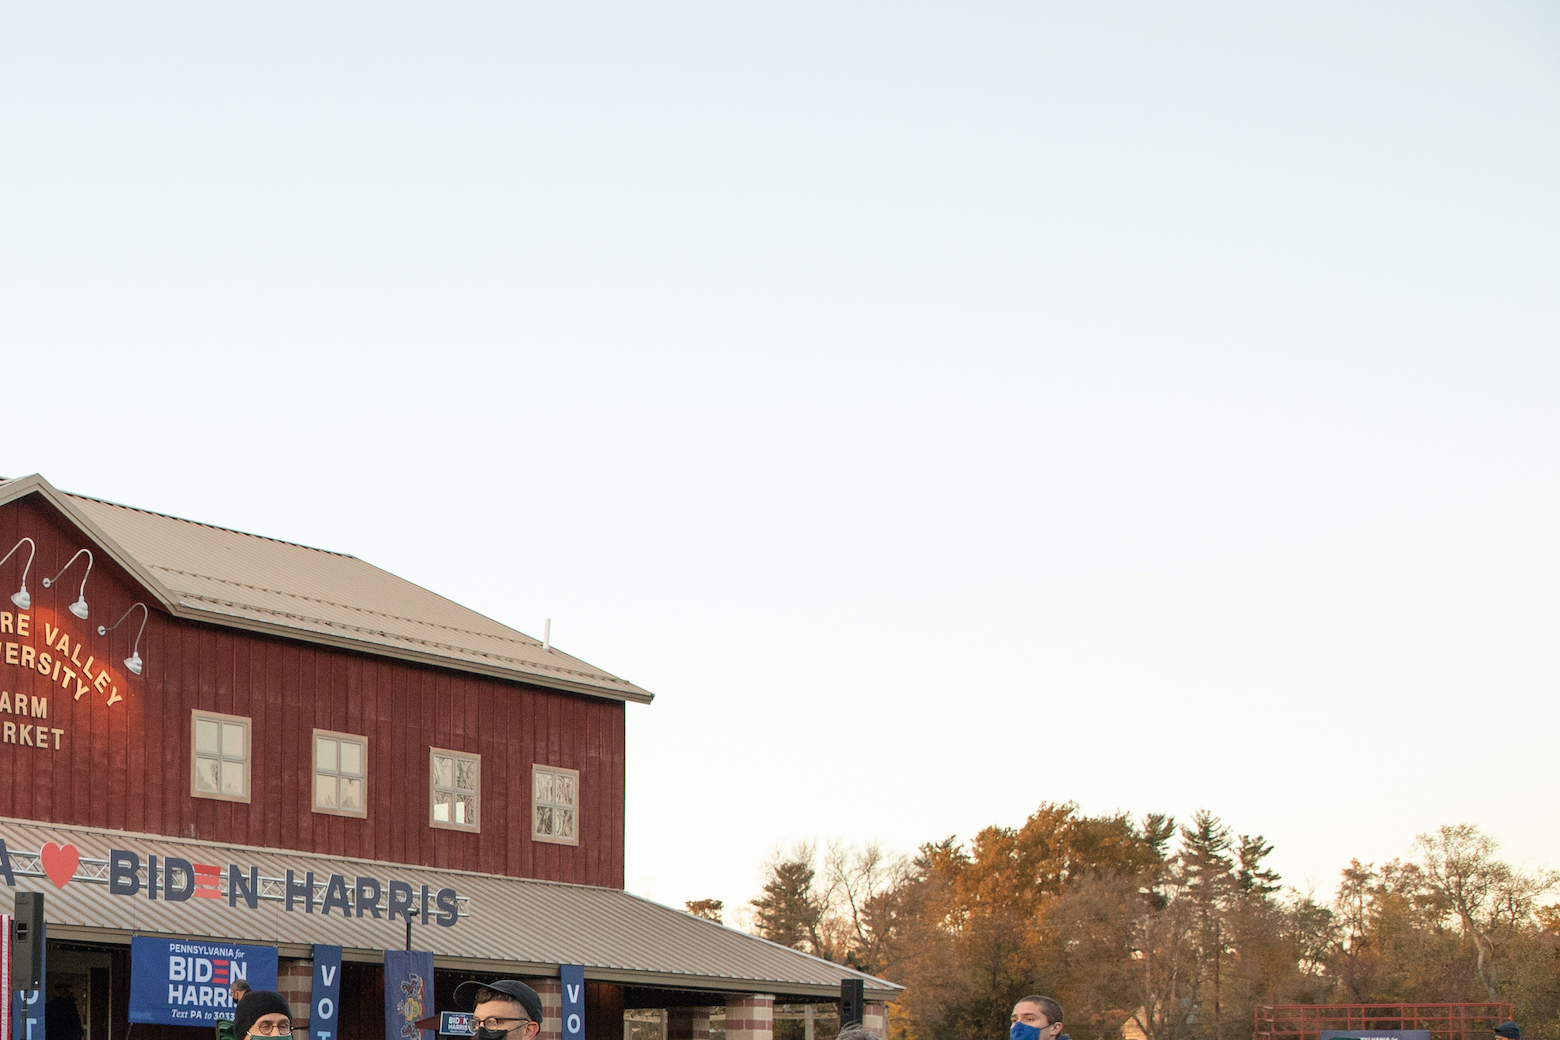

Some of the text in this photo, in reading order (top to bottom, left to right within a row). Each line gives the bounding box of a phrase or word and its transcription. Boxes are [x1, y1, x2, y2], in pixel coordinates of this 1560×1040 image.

[44, 622, 124, 708] VALLEY
[109, 848, 258, 909] BIDEN
[284, 869, 459, 928] HARRIS
[169, 943, 246, 960] PENNSYLVANIA for
[168, 955, 248, 985] BIDEN
[168, 984, 238, 1008] HARRI
[171, 1008, 236, 1021] Text PA to 3033
